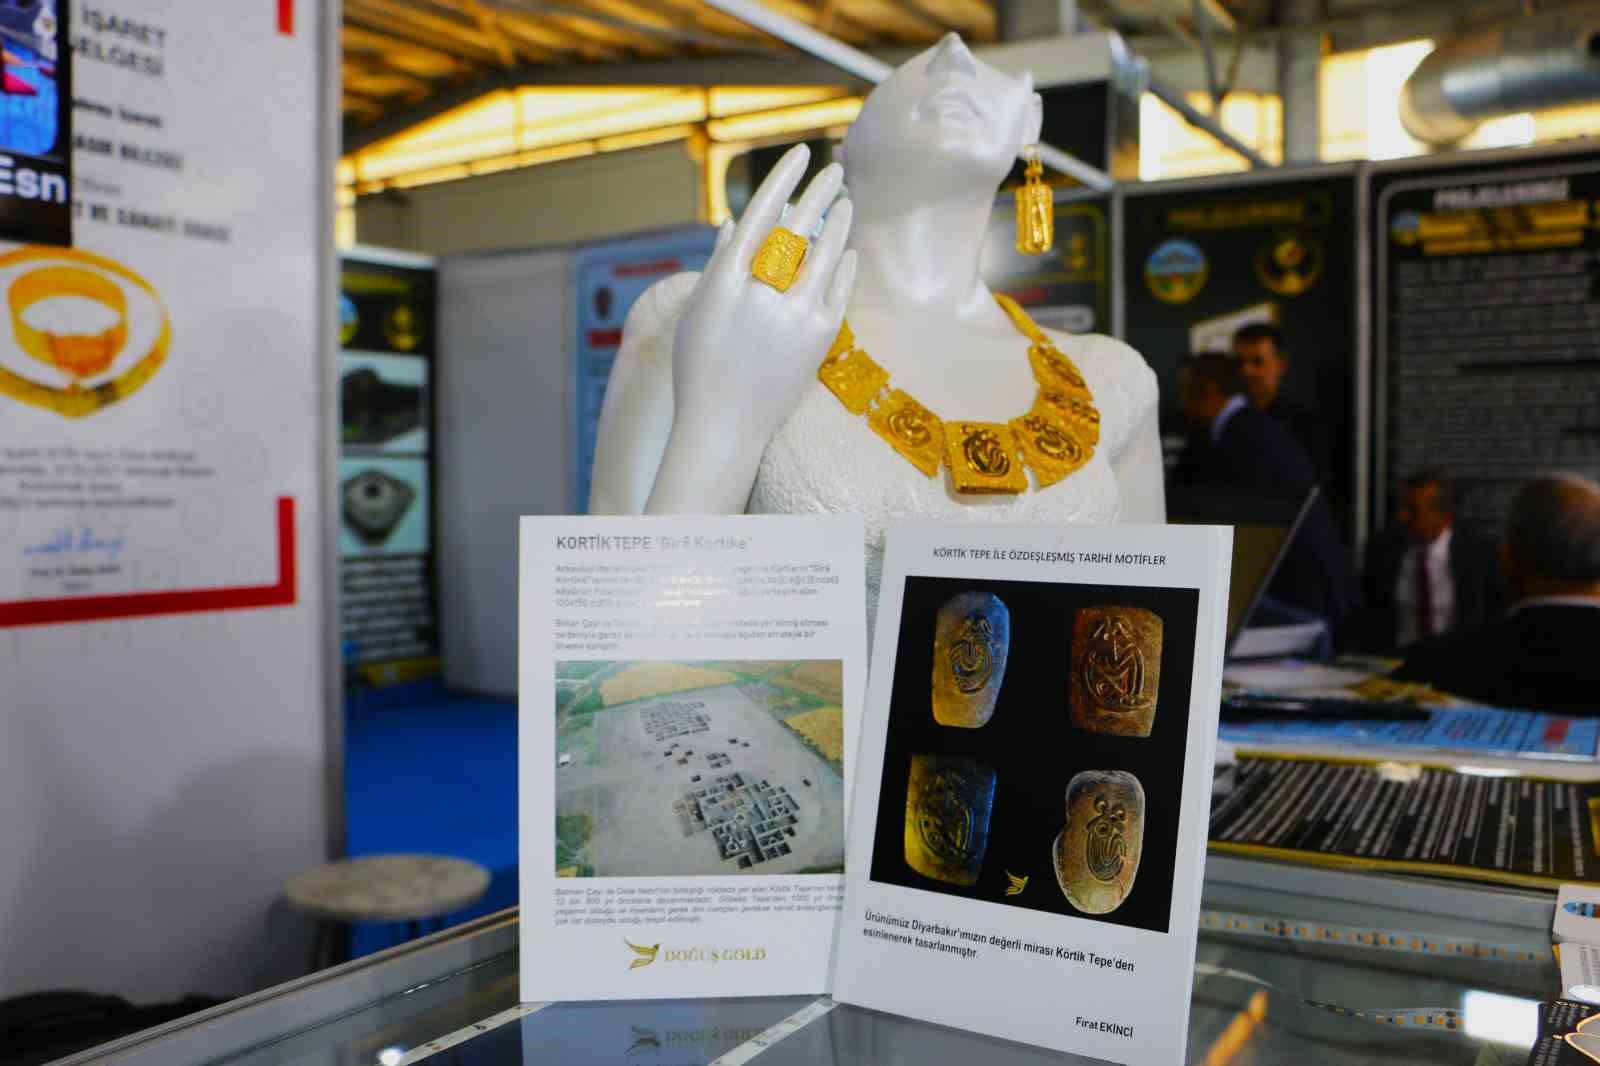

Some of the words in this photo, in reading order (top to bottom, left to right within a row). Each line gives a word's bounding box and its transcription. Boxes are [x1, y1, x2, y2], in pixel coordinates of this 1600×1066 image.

[76, 35, 163, 77] ELGESİ
[613, 536, 652, 551] TEPE
[969, 549, 991, 560] TEPE
[1008, 549, 1076, 564] ÖZDEŞLEŞMİŞ
[1078, 552, 1112, 564] TARİHİ
[1114, 552, 1167, 565] MOTİFLER
[863, 928, 913, 945] esinlenerek
[864, 907, 910, 928] Ürünümüz
[912, 919, 987, 944] Diyarbakır'ımızın
[989, 934, 1022, 951] değerli
[1023, 941, 1054, 957] mirası
[1088, 952, 1135, 971] Tepe'den
[722, 946, 767, 961] GOLD
[1075, 1016, 1099, 1030] Fırat
[1099, 1021, 1134, 1038] EKİNCİ
